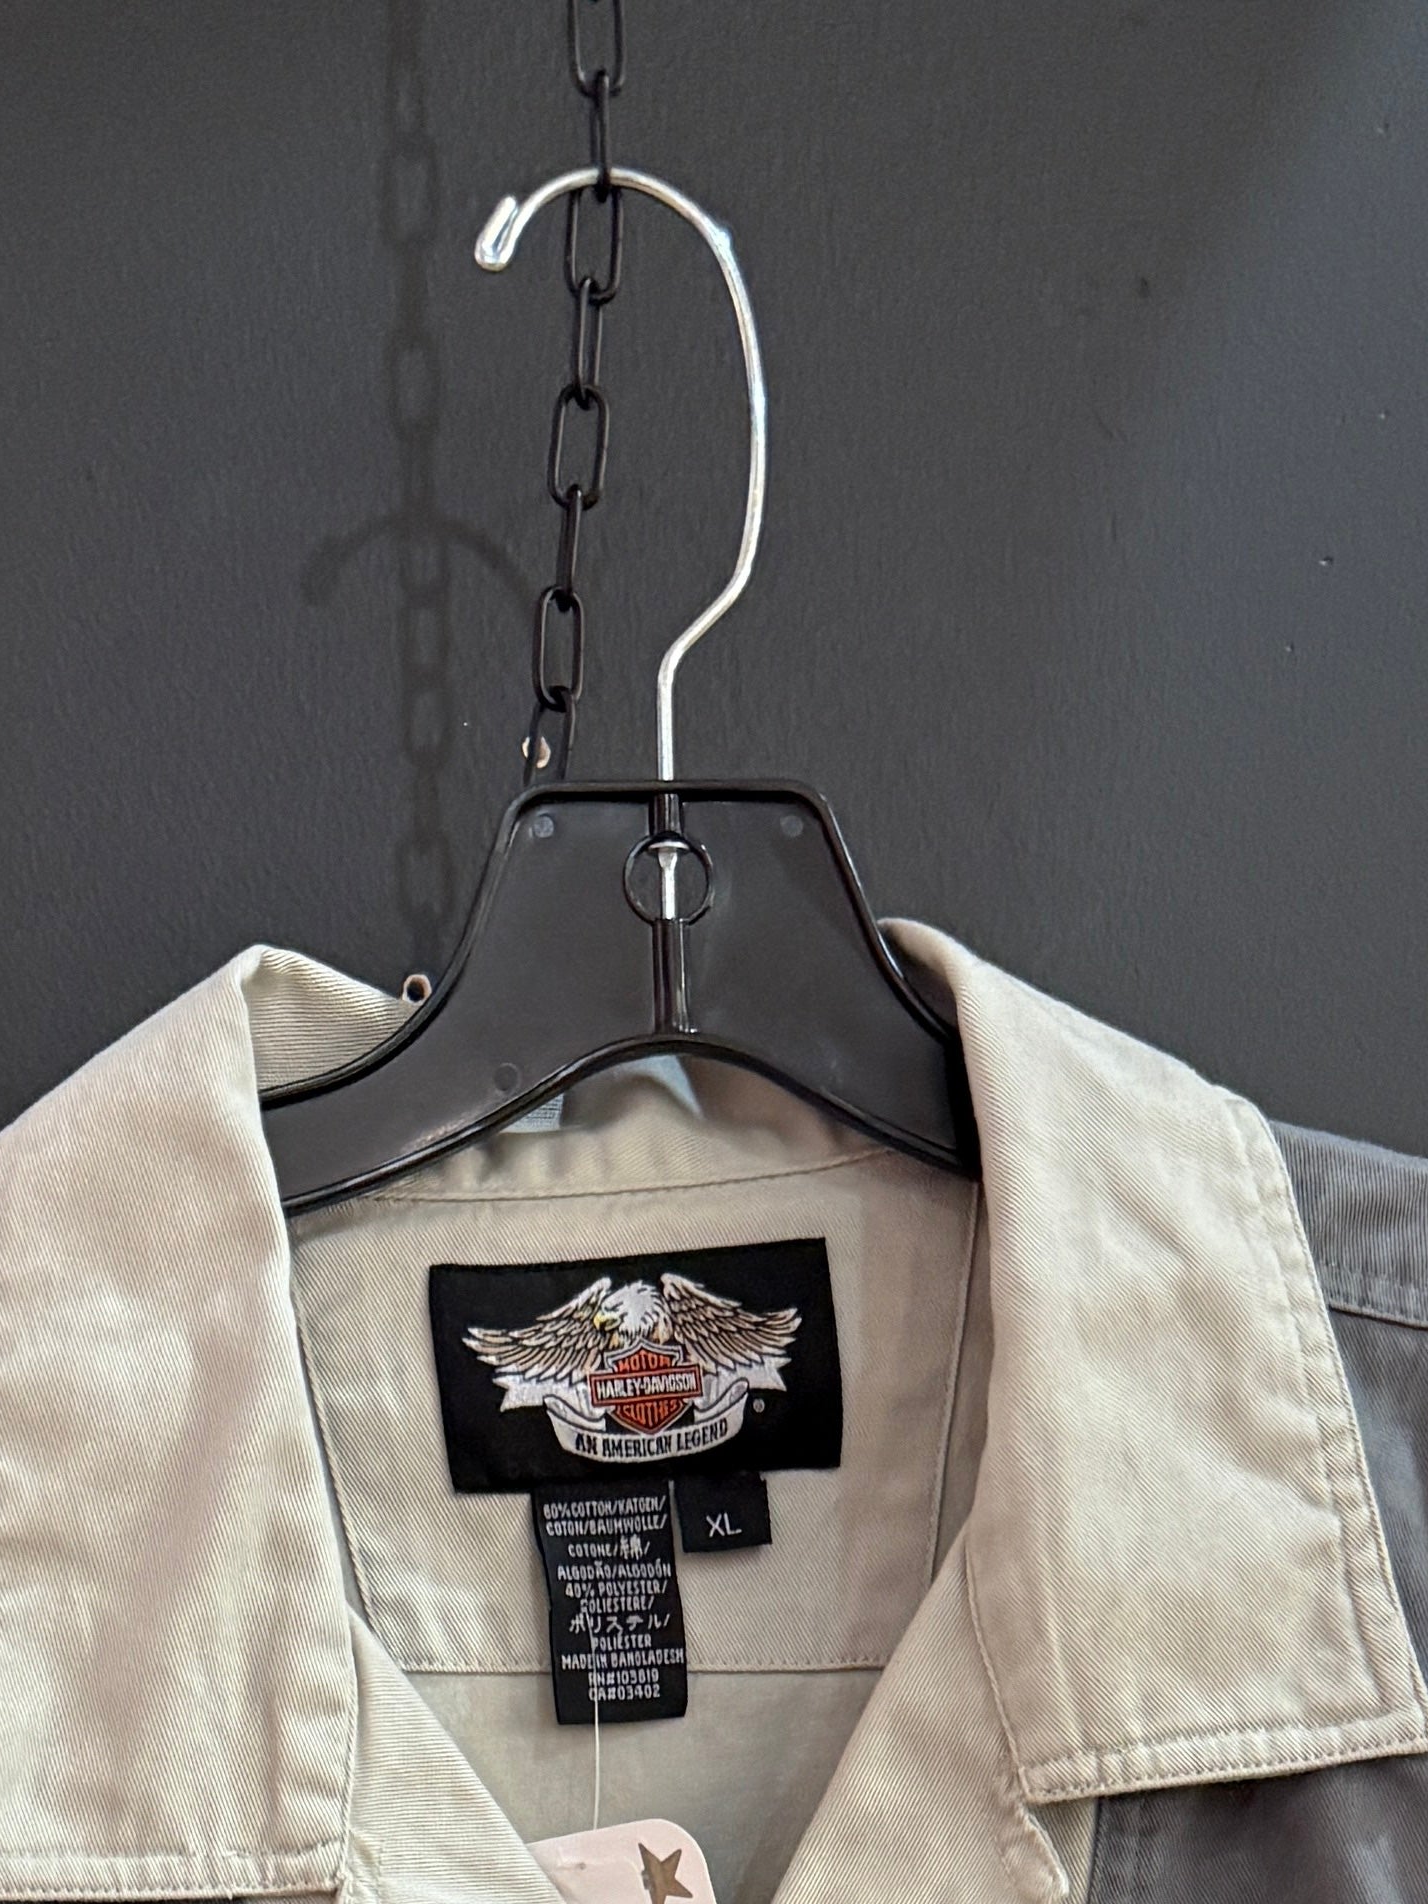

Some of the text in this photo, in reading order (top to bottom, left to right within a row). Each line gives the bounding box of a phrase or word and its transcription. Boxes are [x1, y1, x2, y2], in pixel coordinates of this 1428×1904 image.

[596, 1373, 697, 1400] HARLEY-DAVIDSON
[575, 1417, 728, 1458] AN AMERICAN LEGEND
[706, 1512, 742, 1538] XL
[565, 1582, 595, 1599] 40%
[561, 1654, 593, 1670] MADE
[596, 1653, 608, 1669] IN
